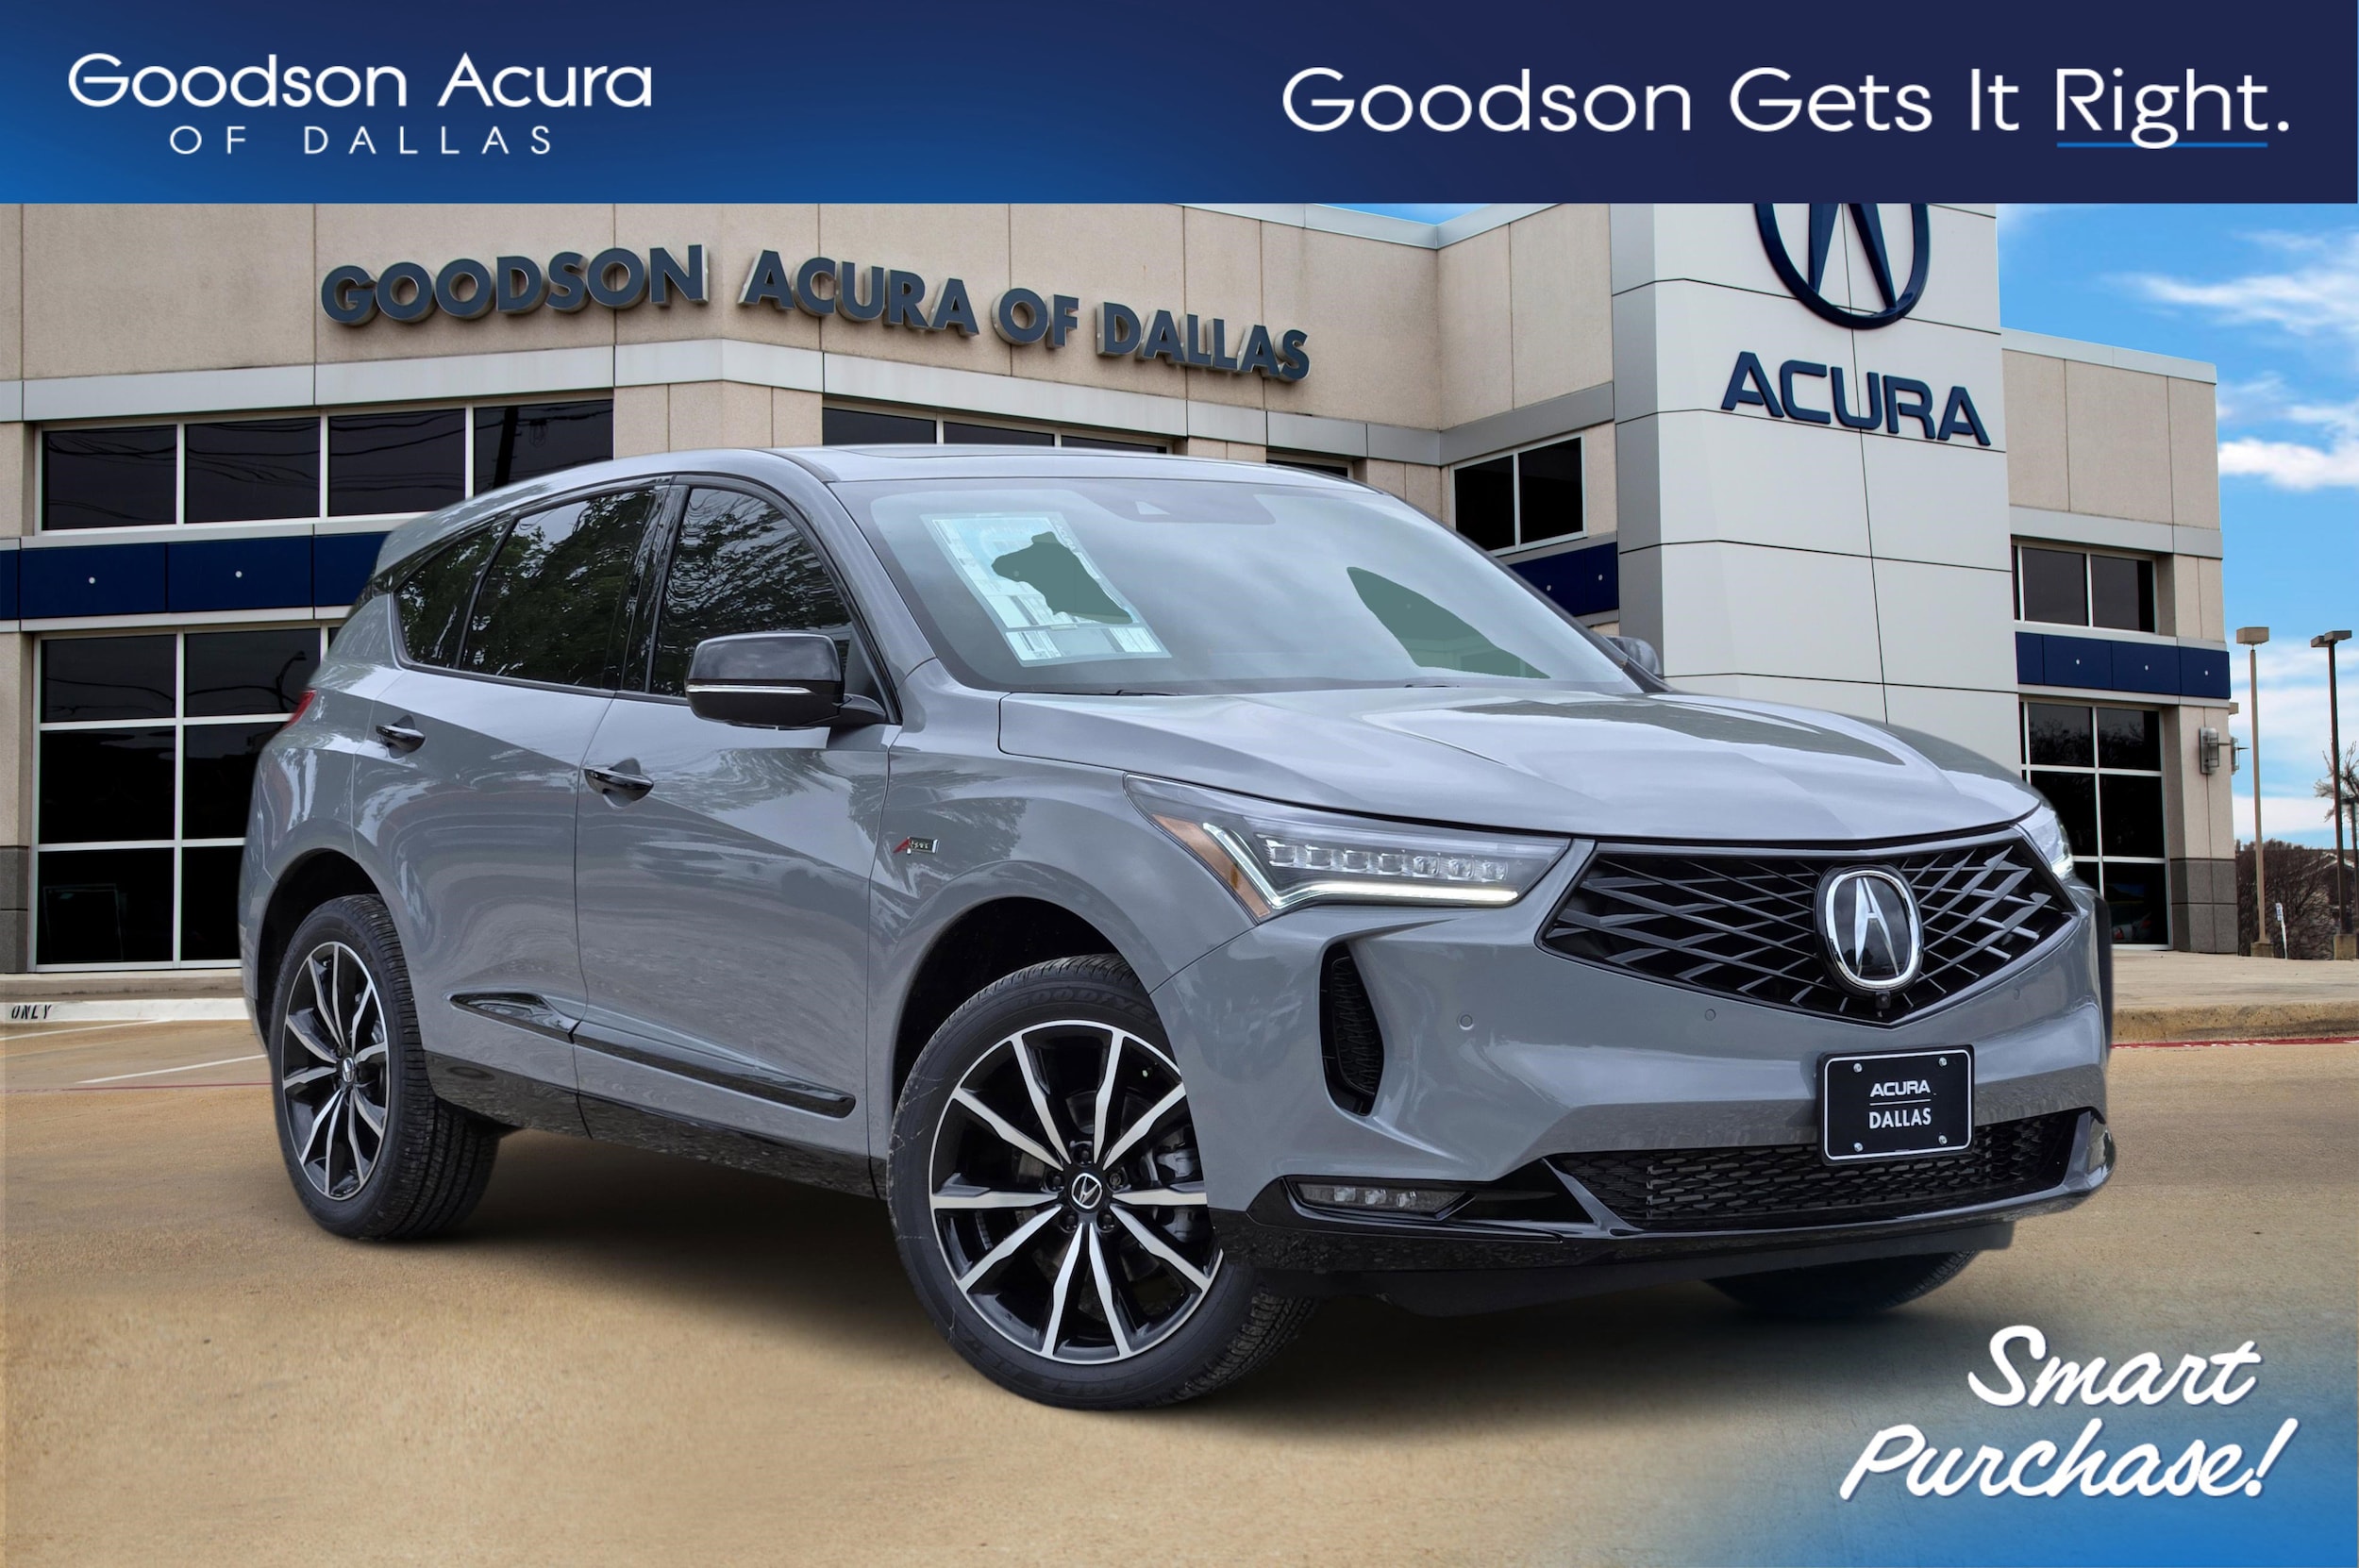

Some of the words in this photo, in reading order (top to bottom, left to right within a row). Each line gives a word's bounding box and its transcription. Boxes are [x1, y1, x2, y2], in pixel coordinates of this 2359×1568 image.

[321, 243, 709, 325] GOODSON
[739, 249, 979, 337] ACURA
[992, 287, 1079, 348] OF
[1096, 301, 1311, 382] DALLAS
[1720, 351, 1993, 447] ACURA
[11, 1004, 53, 1020] ONLY
[1869, 1079, 1932, 1098] ACURA
[1868, 1107, 1932, 1129] DALLAS
